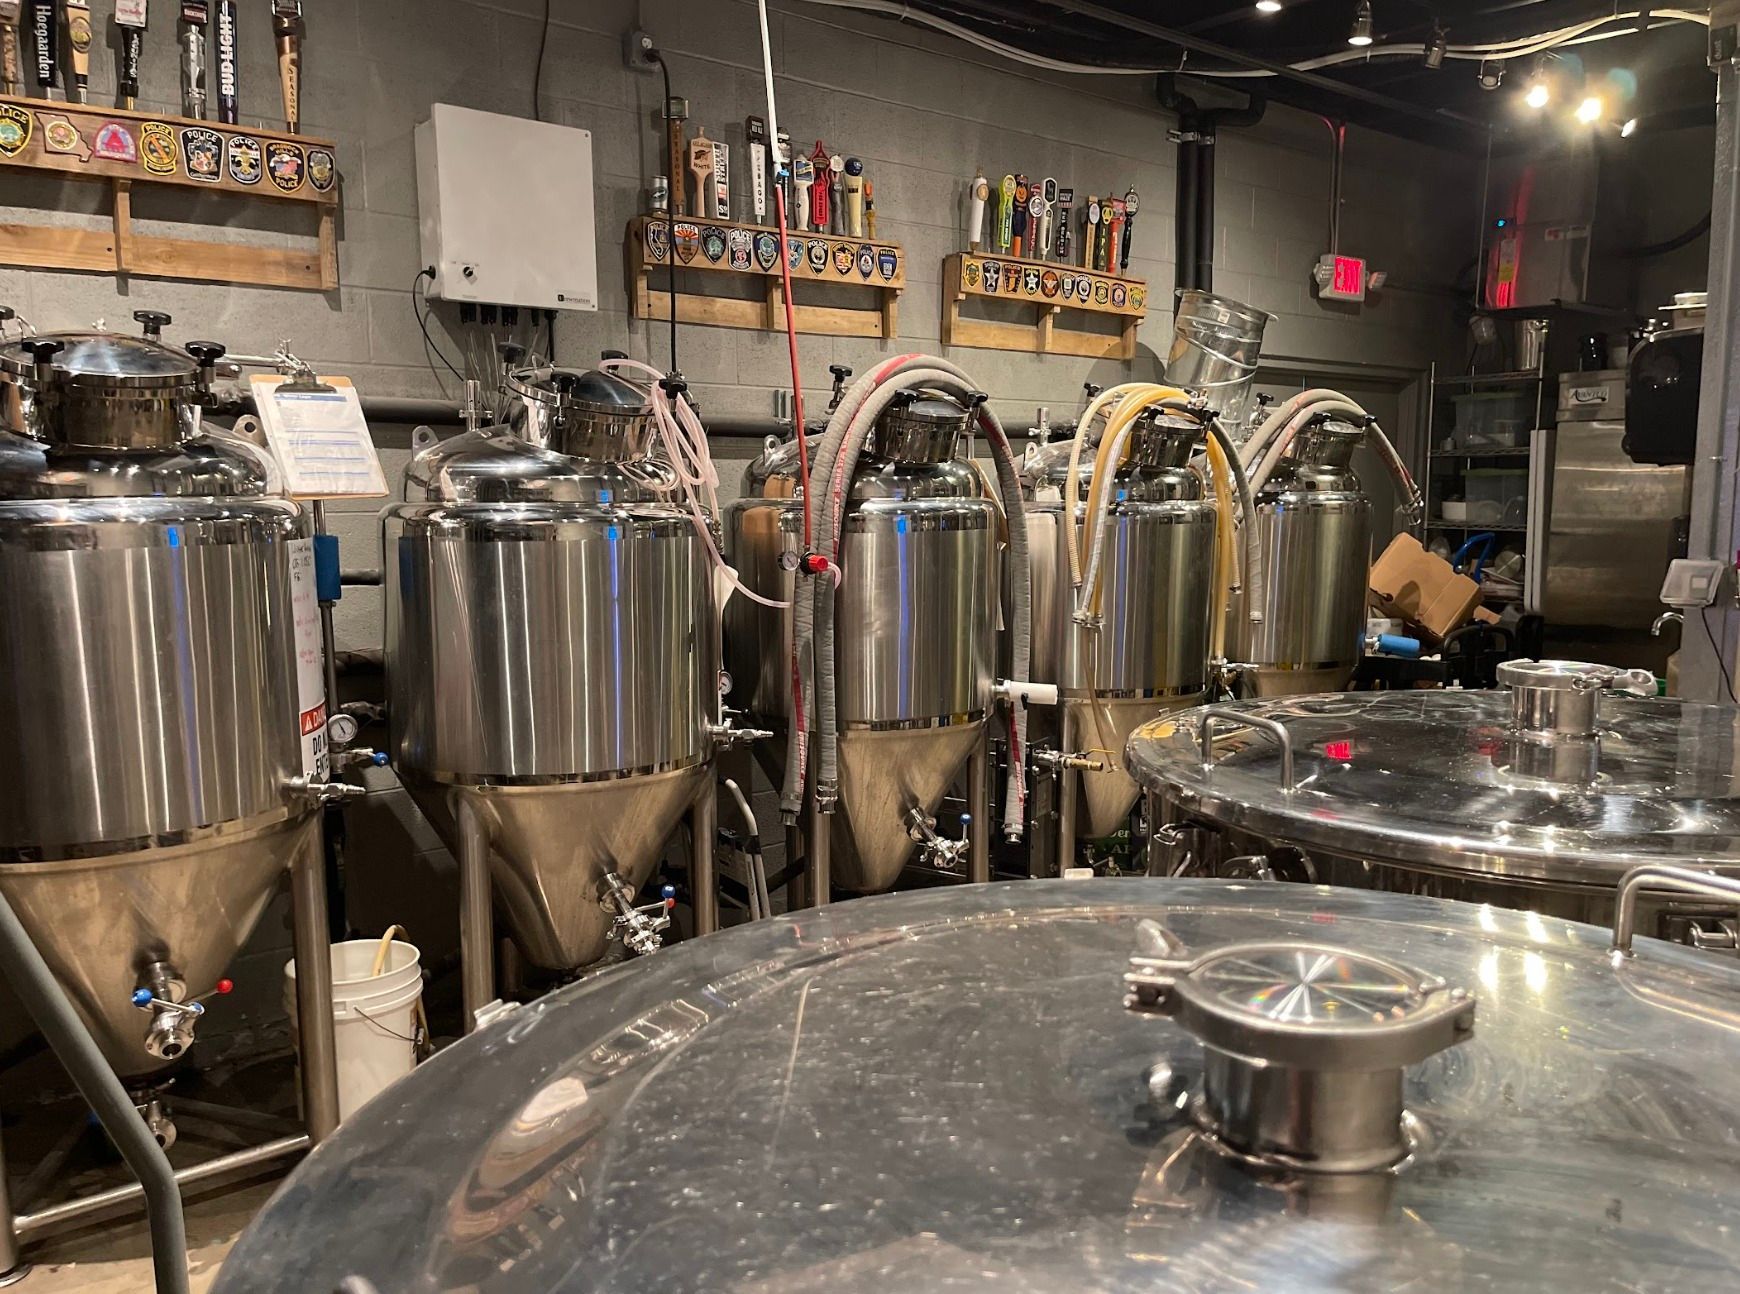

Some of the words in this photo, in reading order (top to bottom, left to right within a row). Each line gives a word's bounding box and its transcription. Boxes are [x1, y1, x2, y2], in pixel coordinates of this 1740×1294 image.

[34, 5, 54, 78] Hoegaarden
[219, 13, 234, 60] LIGHT
[221, 61, 235, 96] BUD
[145, 125, 170, 133] POLICE
[186, 130, 218, 142] POLICE
[229, 138, 259, 150] POLICE
[275, 177, 298, 188] POLICE
[702, 229, 726, 239] POLICE
[730, 230, 750, 240] POLICE
[807, 240, 828, 249] POLICE
[313, 735, 321, 755] DO
